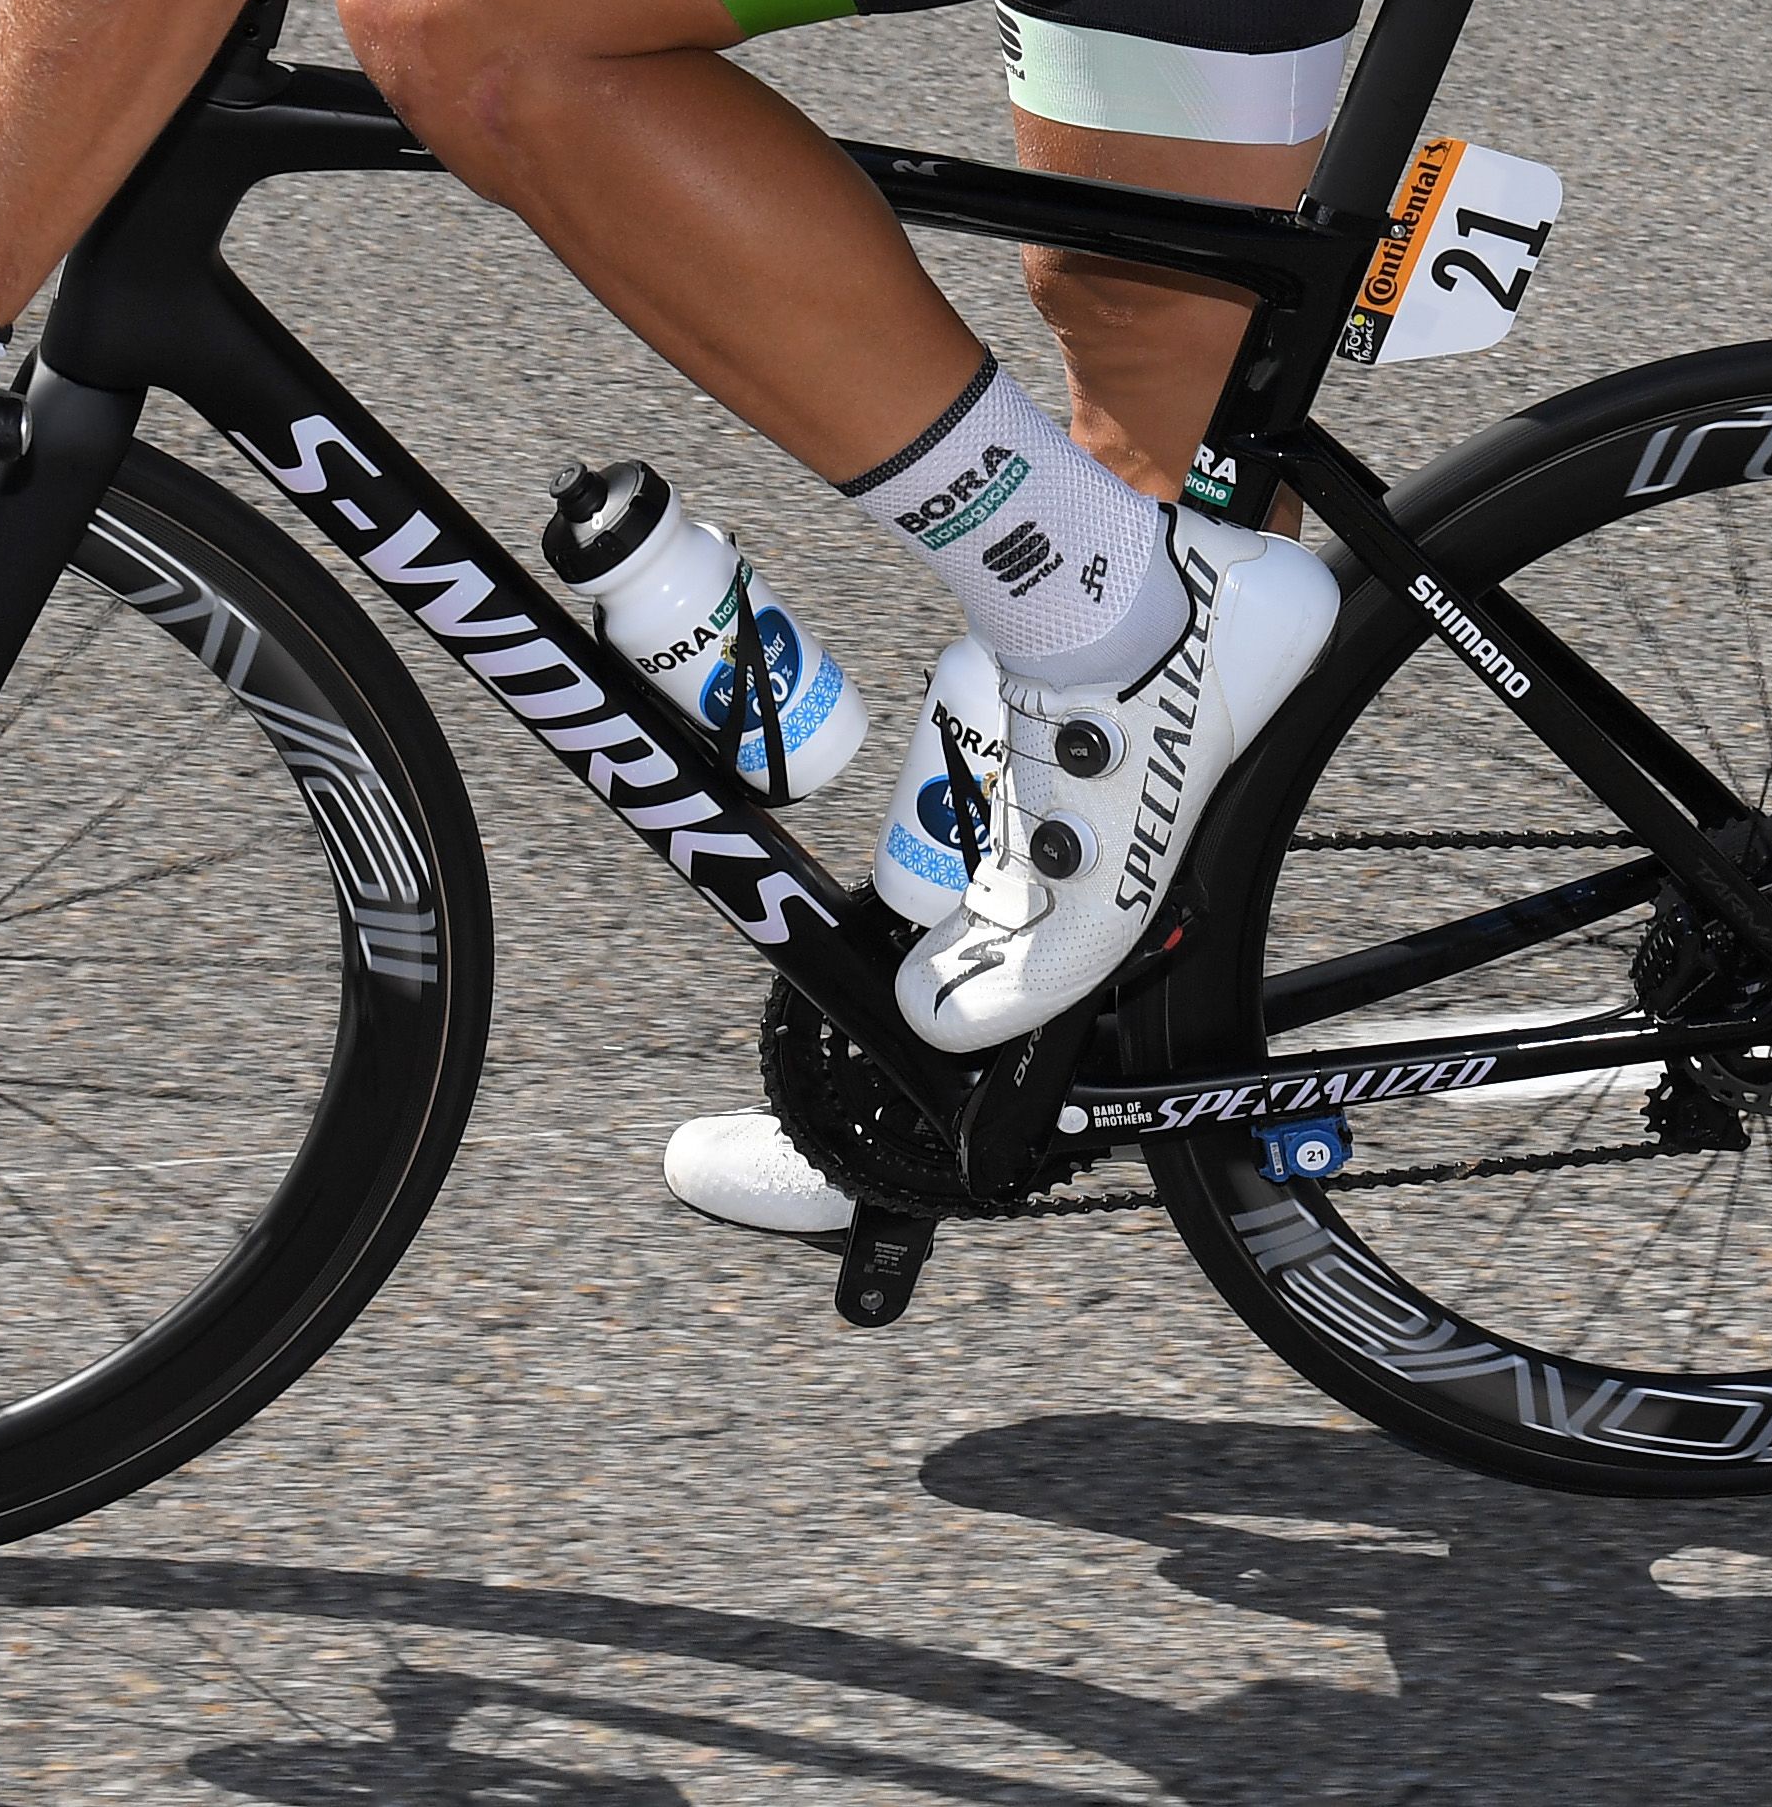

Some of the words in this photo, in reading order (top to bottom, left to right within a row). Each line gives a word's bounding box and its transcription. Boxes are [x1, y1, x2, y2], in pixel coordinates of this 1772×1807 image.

[1431, 207, 1553, 313] 21
[893, 443, 1017, 536] BORA
[920, 461, 1028, 550] hansgrohe
[1009, 551, 1065, 599] sportful
[635, 625, 719, 675] BORA
[1406, 574, 1532, 701] SHIMANO
[227, 414, 840, 945] S-WORKS
[930, 699, 1004, 763] BORA
[1113, 544, 1220, 926] SPECIALIZED
[1092, 1103, 1124, 1118] BAND
[1126, 1101, 1142, 1114] OF
[1093, 1110, 1153, 1128] BROTHERS
[1138, 1055, 1498, 1133] SPECIALIZED
[1306, 1148, 1325, 1163] 21
